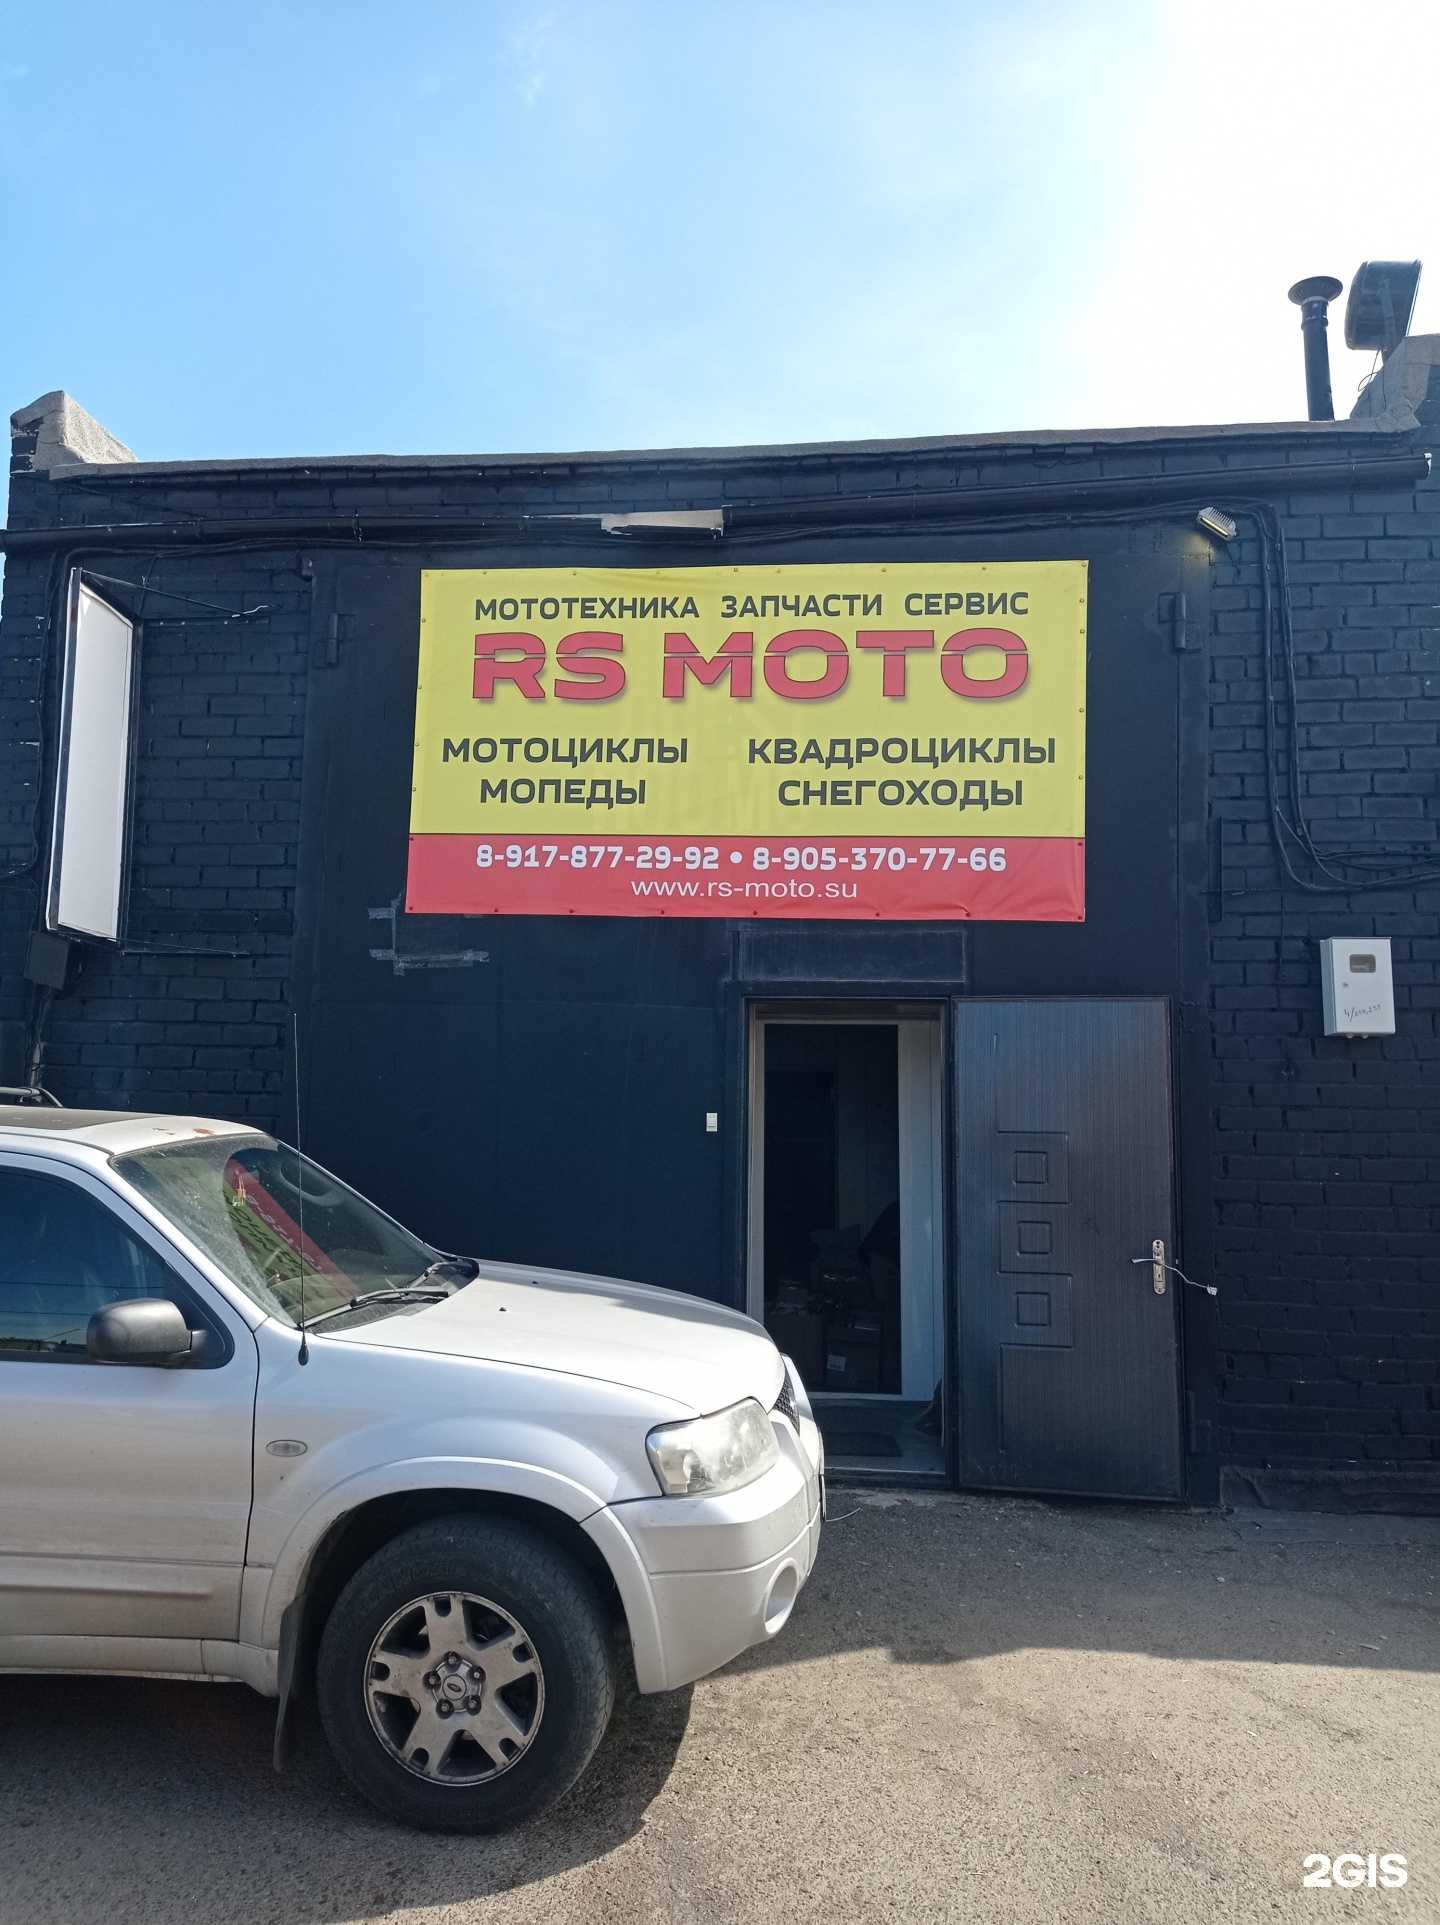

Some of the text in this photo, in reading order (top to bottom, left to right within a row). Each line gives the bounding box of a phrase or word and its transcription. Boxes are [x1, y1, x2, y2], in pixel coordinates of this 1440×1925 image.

[475, 592, 1028, 621] МОТОТЕХНИКА ЗАПЧАСТИ СЕРВИС
[472, 628, 1029, 700] RS MOTO
[443, 738, 688, 768] МОТОЦИКЛЫ
[749, 738, 1055, 770] КВАДРОЦИКЛЫ
[480, 779, 646, 809] МОПЕДЫ
[778, 780, 1023, 811] СНЕГОХОДЫ
[476, 844, 1007, 872] 8-917-877-29-92 8-905-370-77-66
[631, 879, 857, 898] www.rs-moto.su
